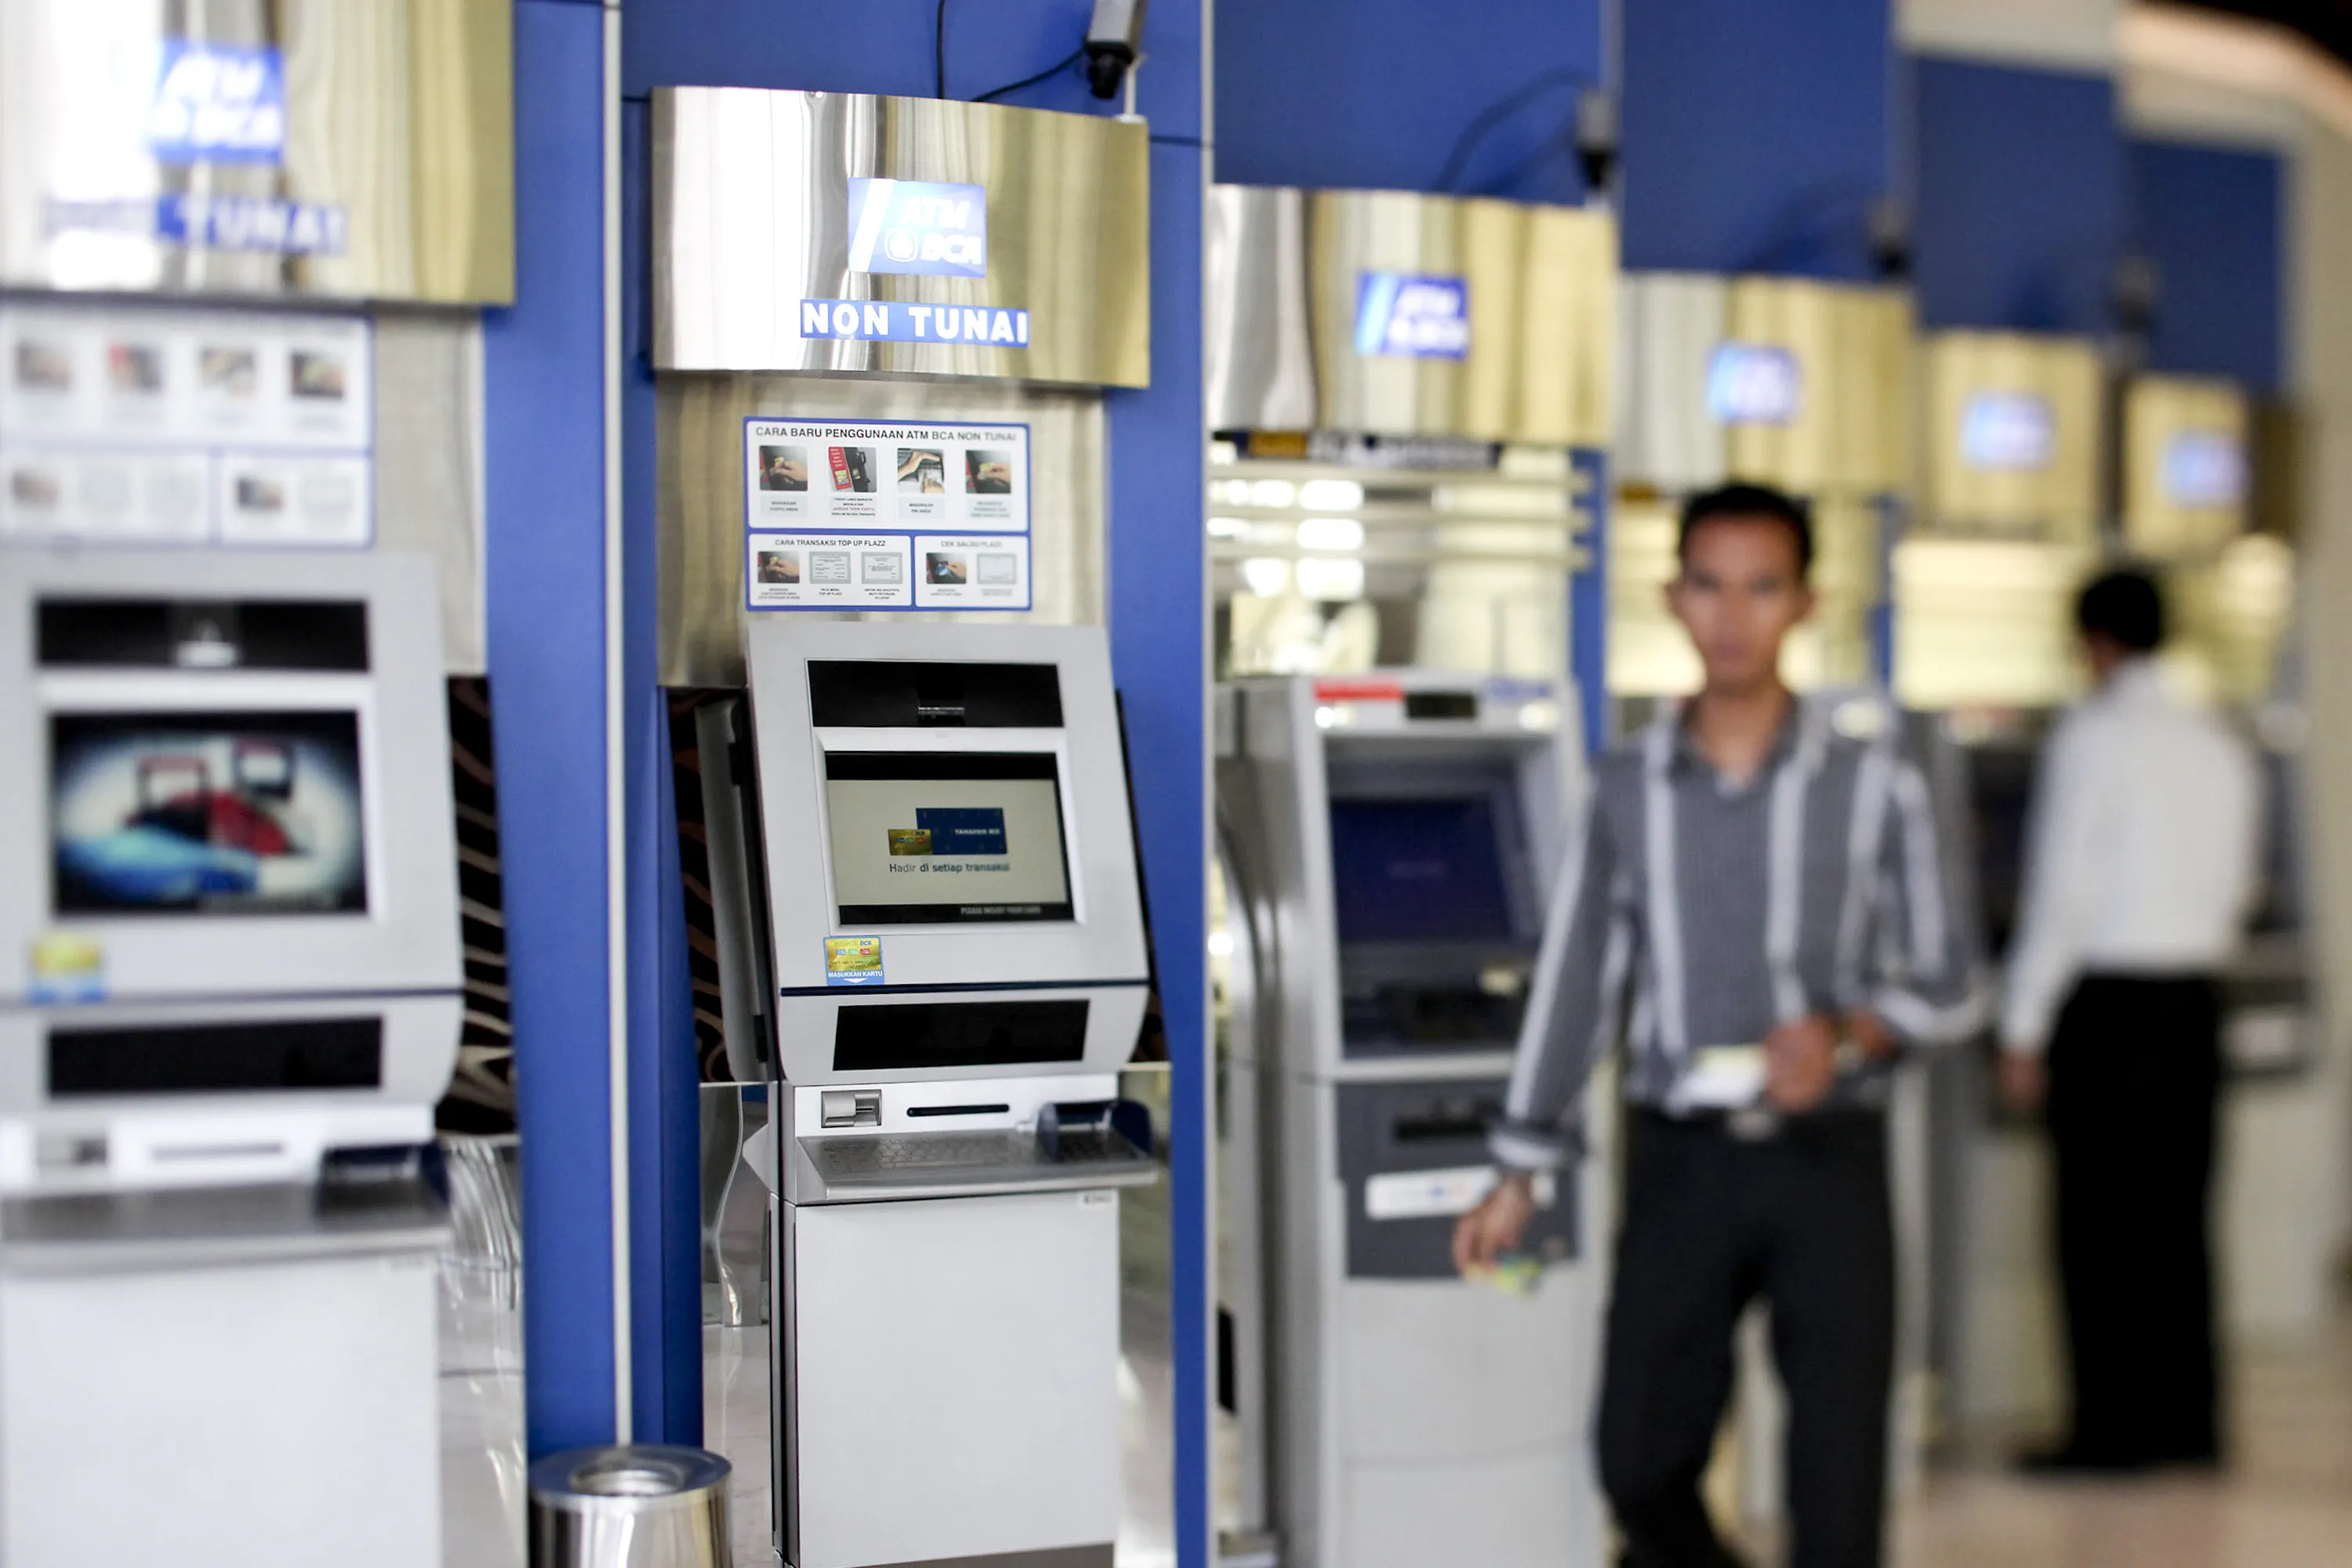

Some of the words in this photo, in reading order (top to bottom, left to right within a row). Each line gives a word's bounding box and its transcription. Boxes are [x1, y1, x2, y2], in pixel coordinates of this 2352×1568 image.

[897, 198, 971, 229] ATM
[920, 234, 983, 265] BCA
[803, 303, 889, 336] NON
[907, 307, 1029, 344] TUNAI
[756, 426, 787, 437] CARA
[790, 427, 822, 437] BARU
[826, 428, 904, 440] PENGGUNAAN
[906, 430, 928, 440] ATM
[931, 430, 954, 441] BCA
[957, 431, 980, 441] NON
[890, 863, 916, 873] Hadir
[920, 863, 929, 873] di
[932, 863, 962, 874] setiap
